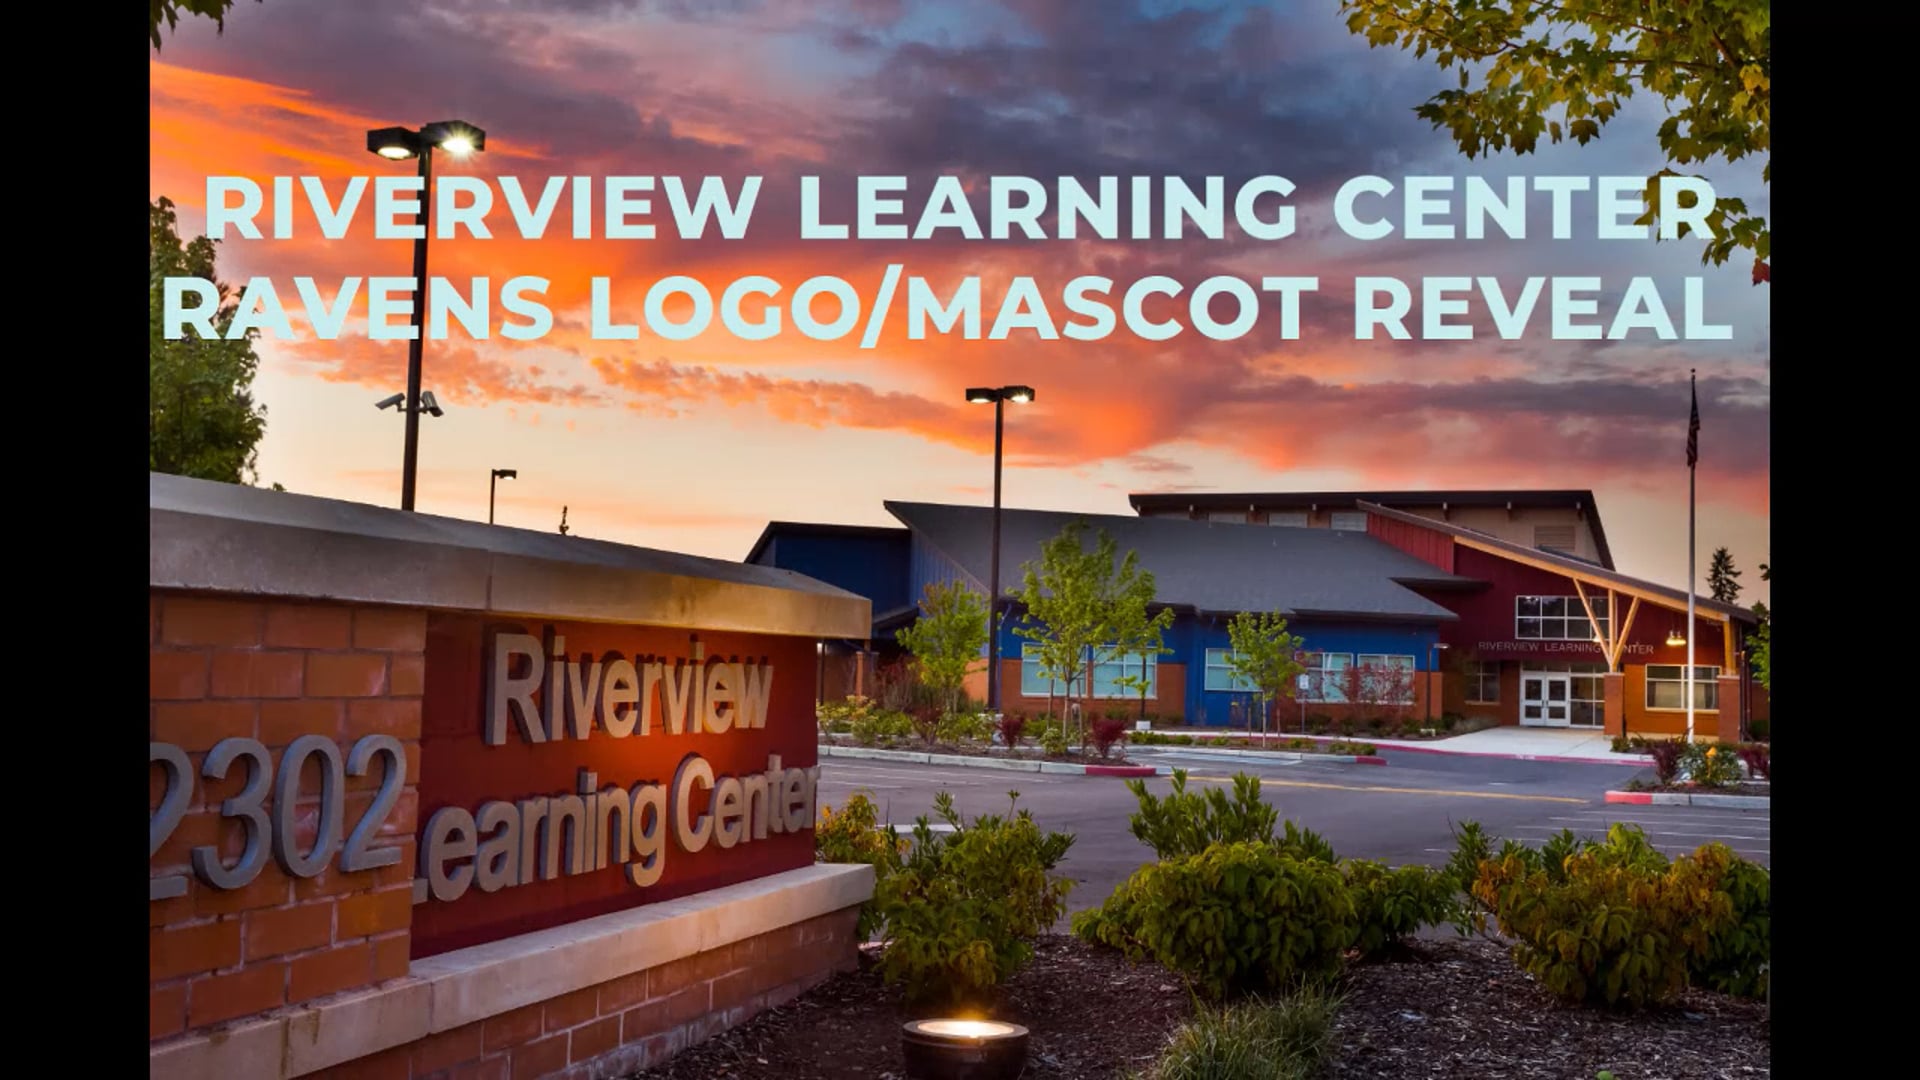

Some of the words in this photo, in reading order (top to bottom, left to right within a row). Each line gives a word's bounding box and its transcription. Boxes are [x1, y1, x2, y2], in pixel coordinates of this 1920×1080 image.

[485, 632, 774, 745] Riverview
[1478, 640, 1540, 651] RIVERVIEW
[1544, 642, 1601, 654] LEARNING
[1622, 642, 1654, 655] NTER
[671, 753, 821, 853] Center
